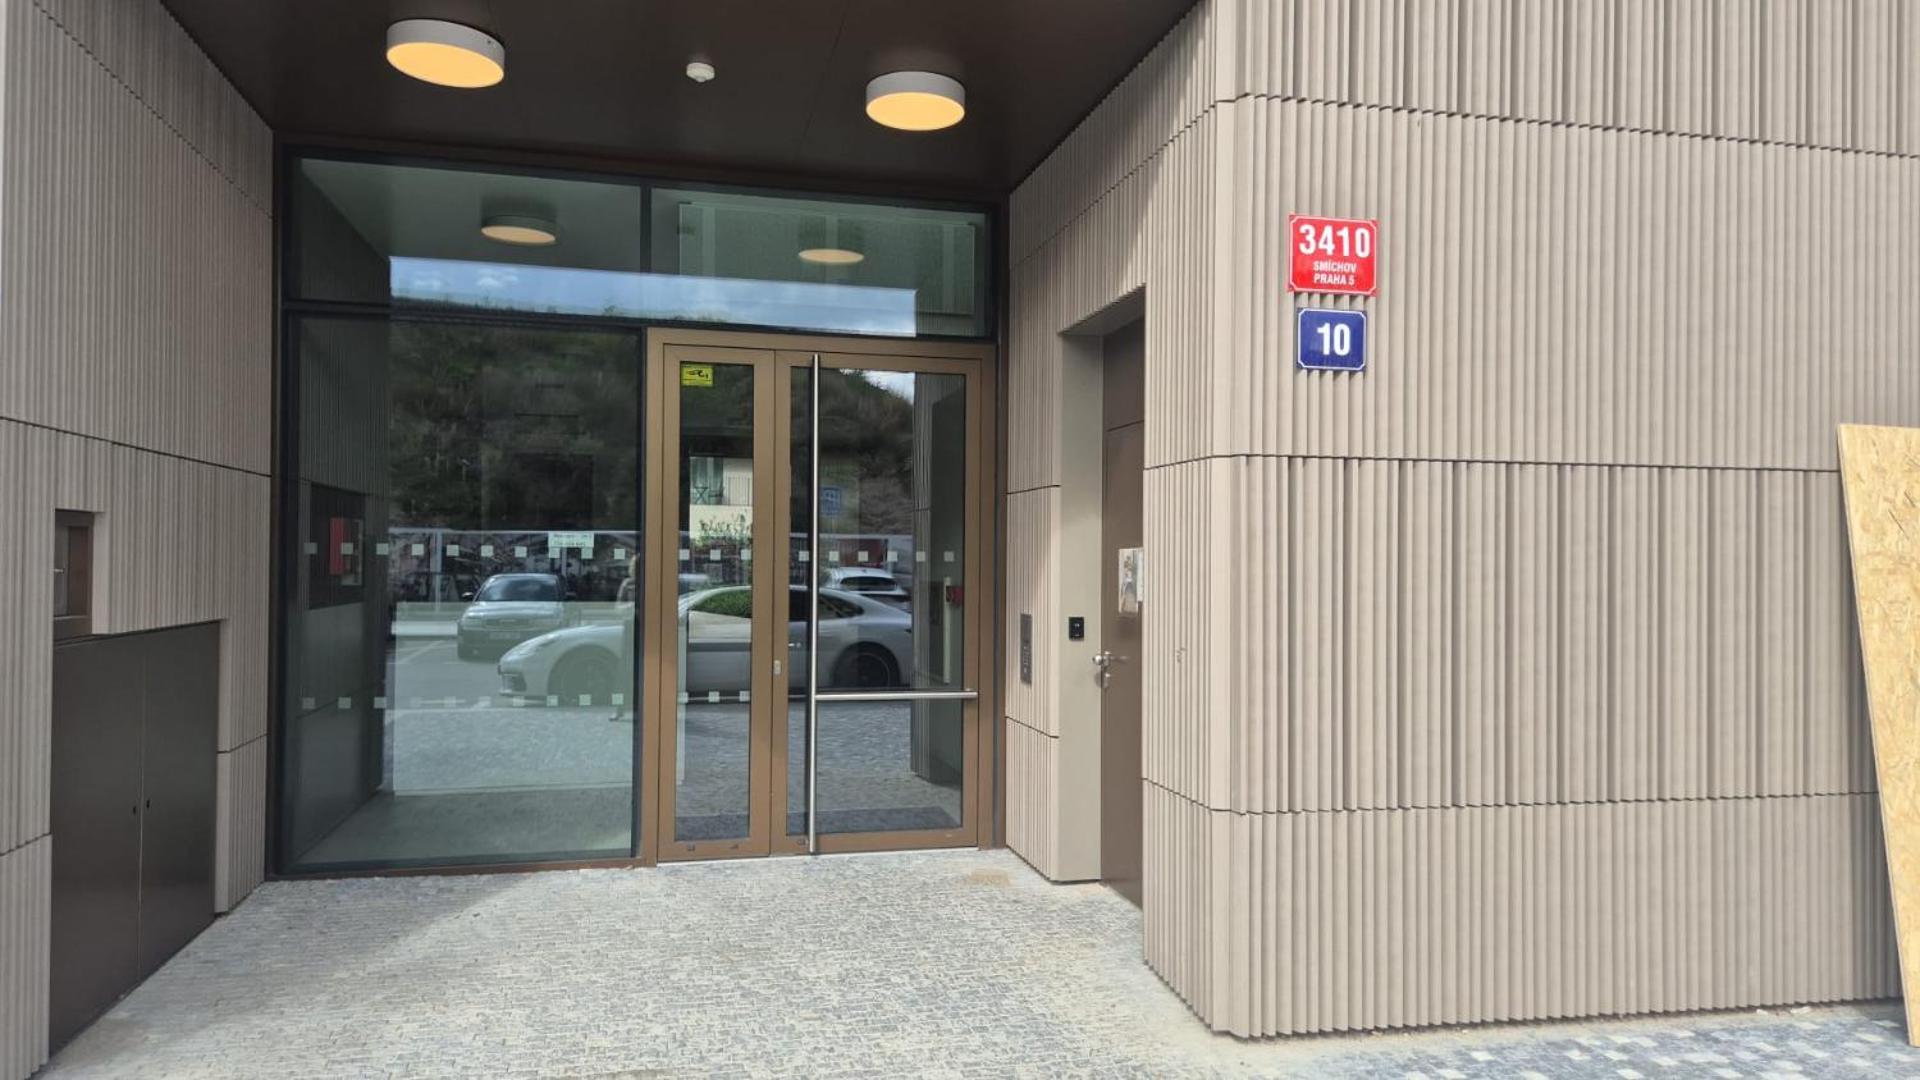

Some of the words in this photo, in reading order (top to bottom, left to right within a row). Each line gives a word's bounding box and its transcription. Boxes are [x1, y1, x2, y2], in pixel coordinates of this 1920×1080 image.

[1299, 224, 1370, 258] 3410
[1313, 260, 1357, 273] SMÍCHOV
[1314, 273, 1347, 285] PRAHA
[1348, 275, 1355, 286] 5
[1317, 322, 1351, 356] 10
